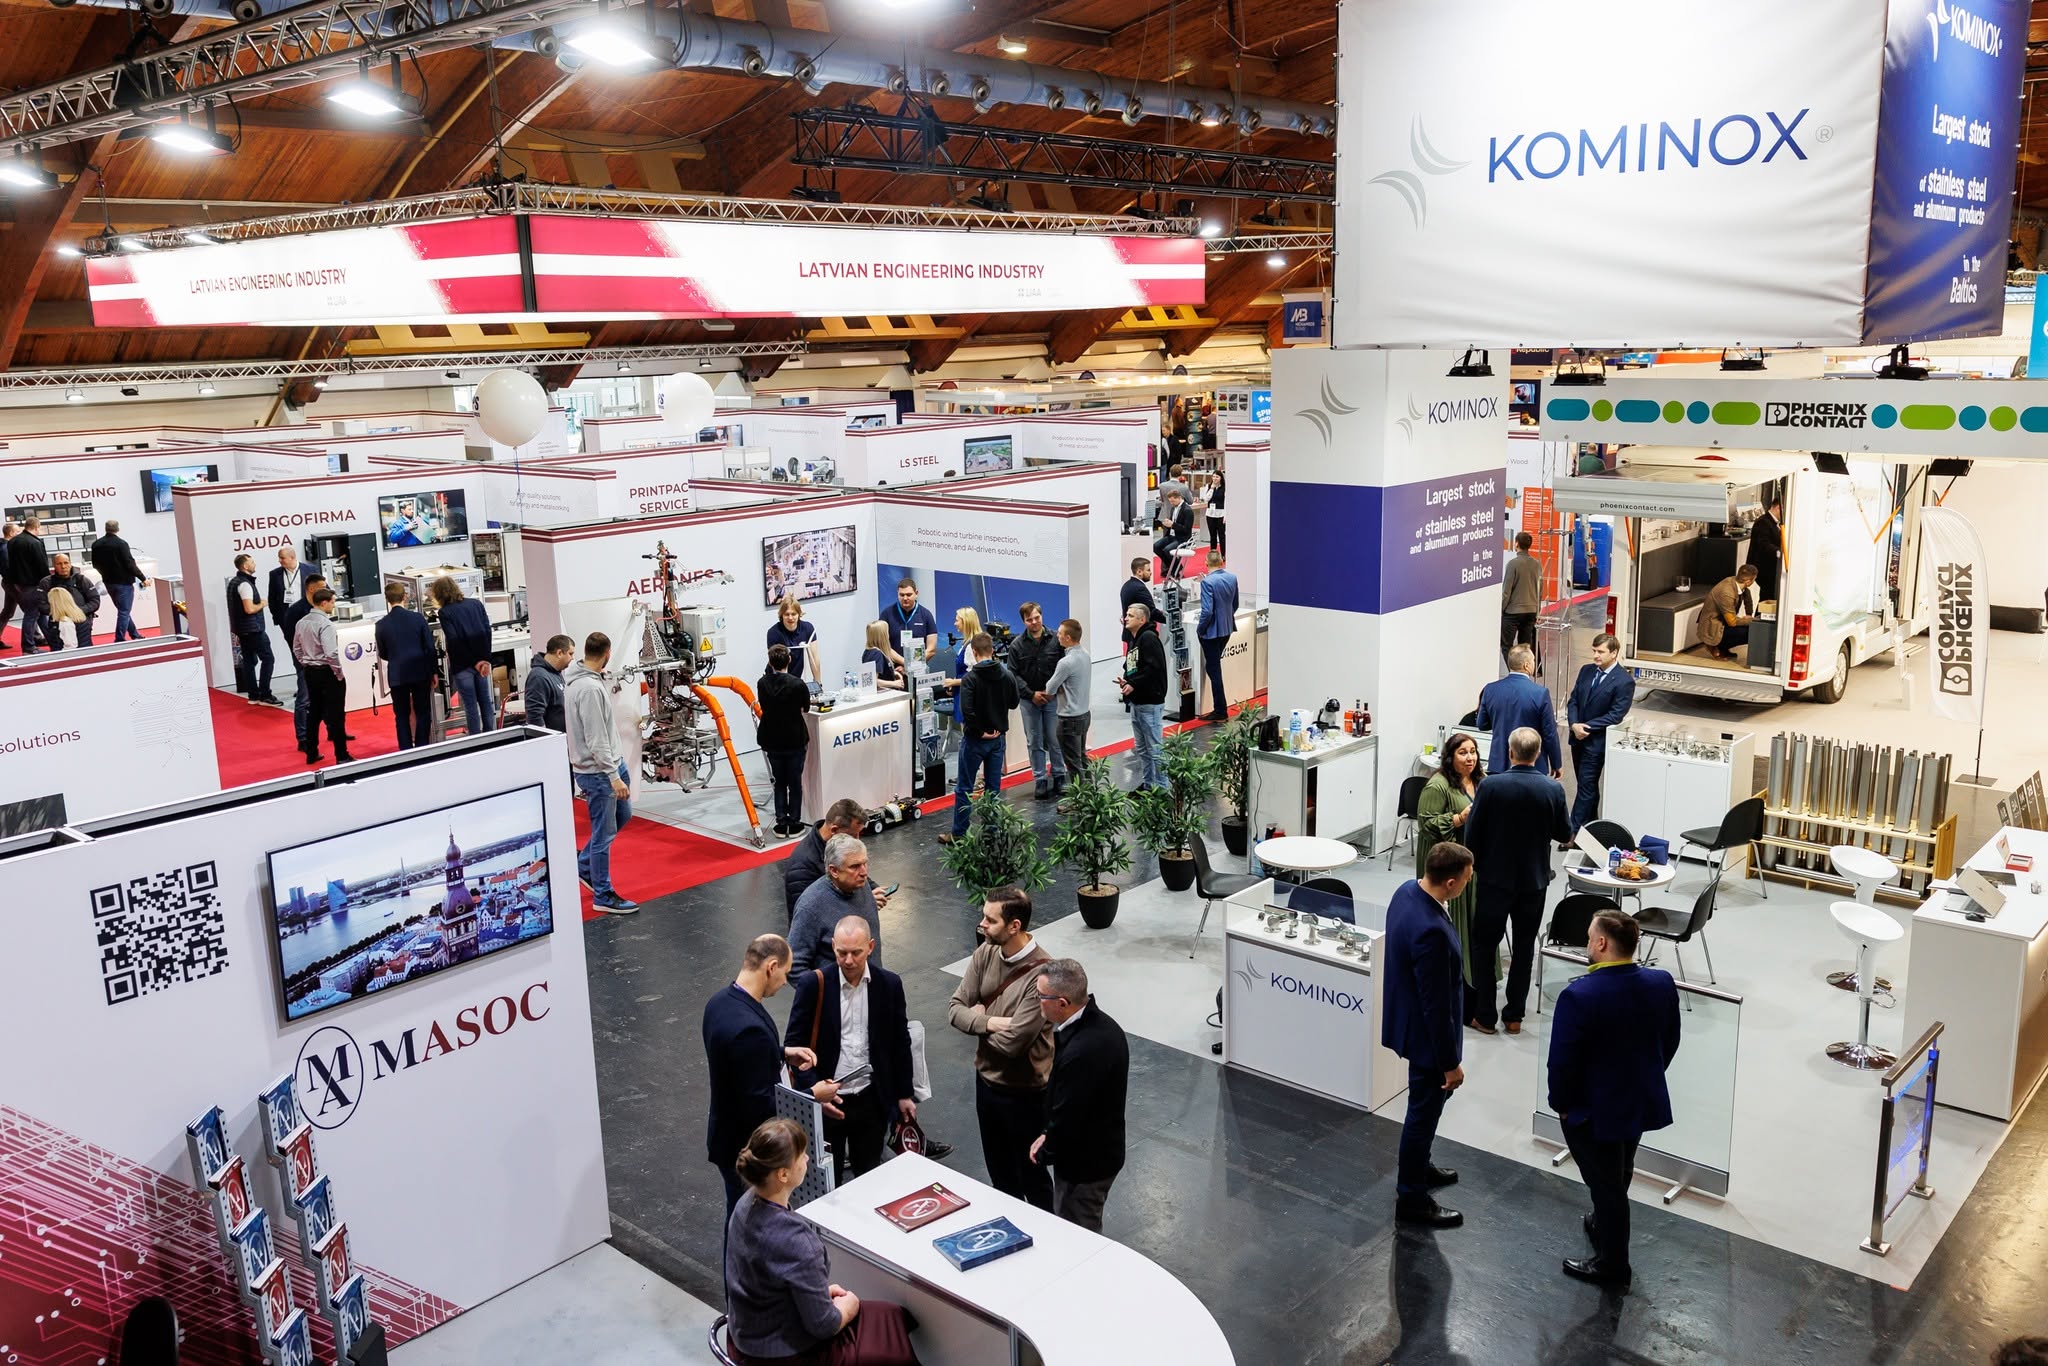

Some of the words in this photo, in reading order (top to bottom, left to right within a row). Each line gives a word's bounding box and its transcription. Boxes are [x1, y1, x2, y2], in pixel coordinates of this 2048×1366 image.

[1932, 104, 1966, 145] Largest
[1969, 116, 1990, 148] stock
[1919, 175, 1927, 193] of
[1928, 168, 1964, 199] stainless
[1968, 176, 1988, 202] steel
[1914, 201, 1924, 218] and
[1926, 199, 1956, 223] aluminum
[1958, 207, 1985, 228] products
[800, 262, 868, 278] LATVIAN
[874, 264, 974, 279] ENGINEERING
[979, 264, 1045, 279] INDUSTRY
[1963, 254, 1970, 272] in
[1972, 255, 1981, 273] the
[190, 278, 227, 294] LATVIAN
[229, 273, 292, 292] ENGINEERING
[295, 268, 347, 286] INDUSTRY
[1950, 277, 1978, 304] Baltics
[1428, 396, 1498, 424] KOMINOX
[1790, 415, 1867, 428] CONTACT
[900, 458, 910, 468] LS
[912, 456, 940, 466] STEEL
[14, 492, 46, 504] VRV
[50, 486, 117, 502] TRADING
[629, 482, 688, 498] PRINTPAC
[1426, 484, 1464, 507] Largest
[1468, 478, 1495, 497] stock
[640, 498, 688, 514] SERVICE
[1600, 503, 1675, 512] phoenixcontact.com
[232, 509, 356, 532] ENERGOFIRMA
[1416, 528, 1422, 539] of
[1425, 515, 1466, 536] stainless
[1471, 507, 1494, 526] steel
[234, 534, 292, 552] JAUDA
[918, 528, 942, 536] Robotic
[942, 530, 958, 538] wind
[960, 532, 982, 540] turbine
[984, 534, 1020, 544] inspection,
[1410, 542, 1422, 554] and
[1424, 533, 1458, 552] aluminum
[1462, 526, 1494, 546] products
[954, 544, 966, 552] and
[968, 544, 996, 554] AI-driven
[997, 548, 1028, 558] solutions
[1473, 551, 1480, 562] in
[1482, 548, 1493, 560] the
[1462, 564, 1492, 584] Baltics
[0, 730, 81, 755] solutions
[833, 720, 900, 748] AERONES
[1271, 972, 1364, 1014] KOMINOX
[369, 981, 550, 1080] MASOC
